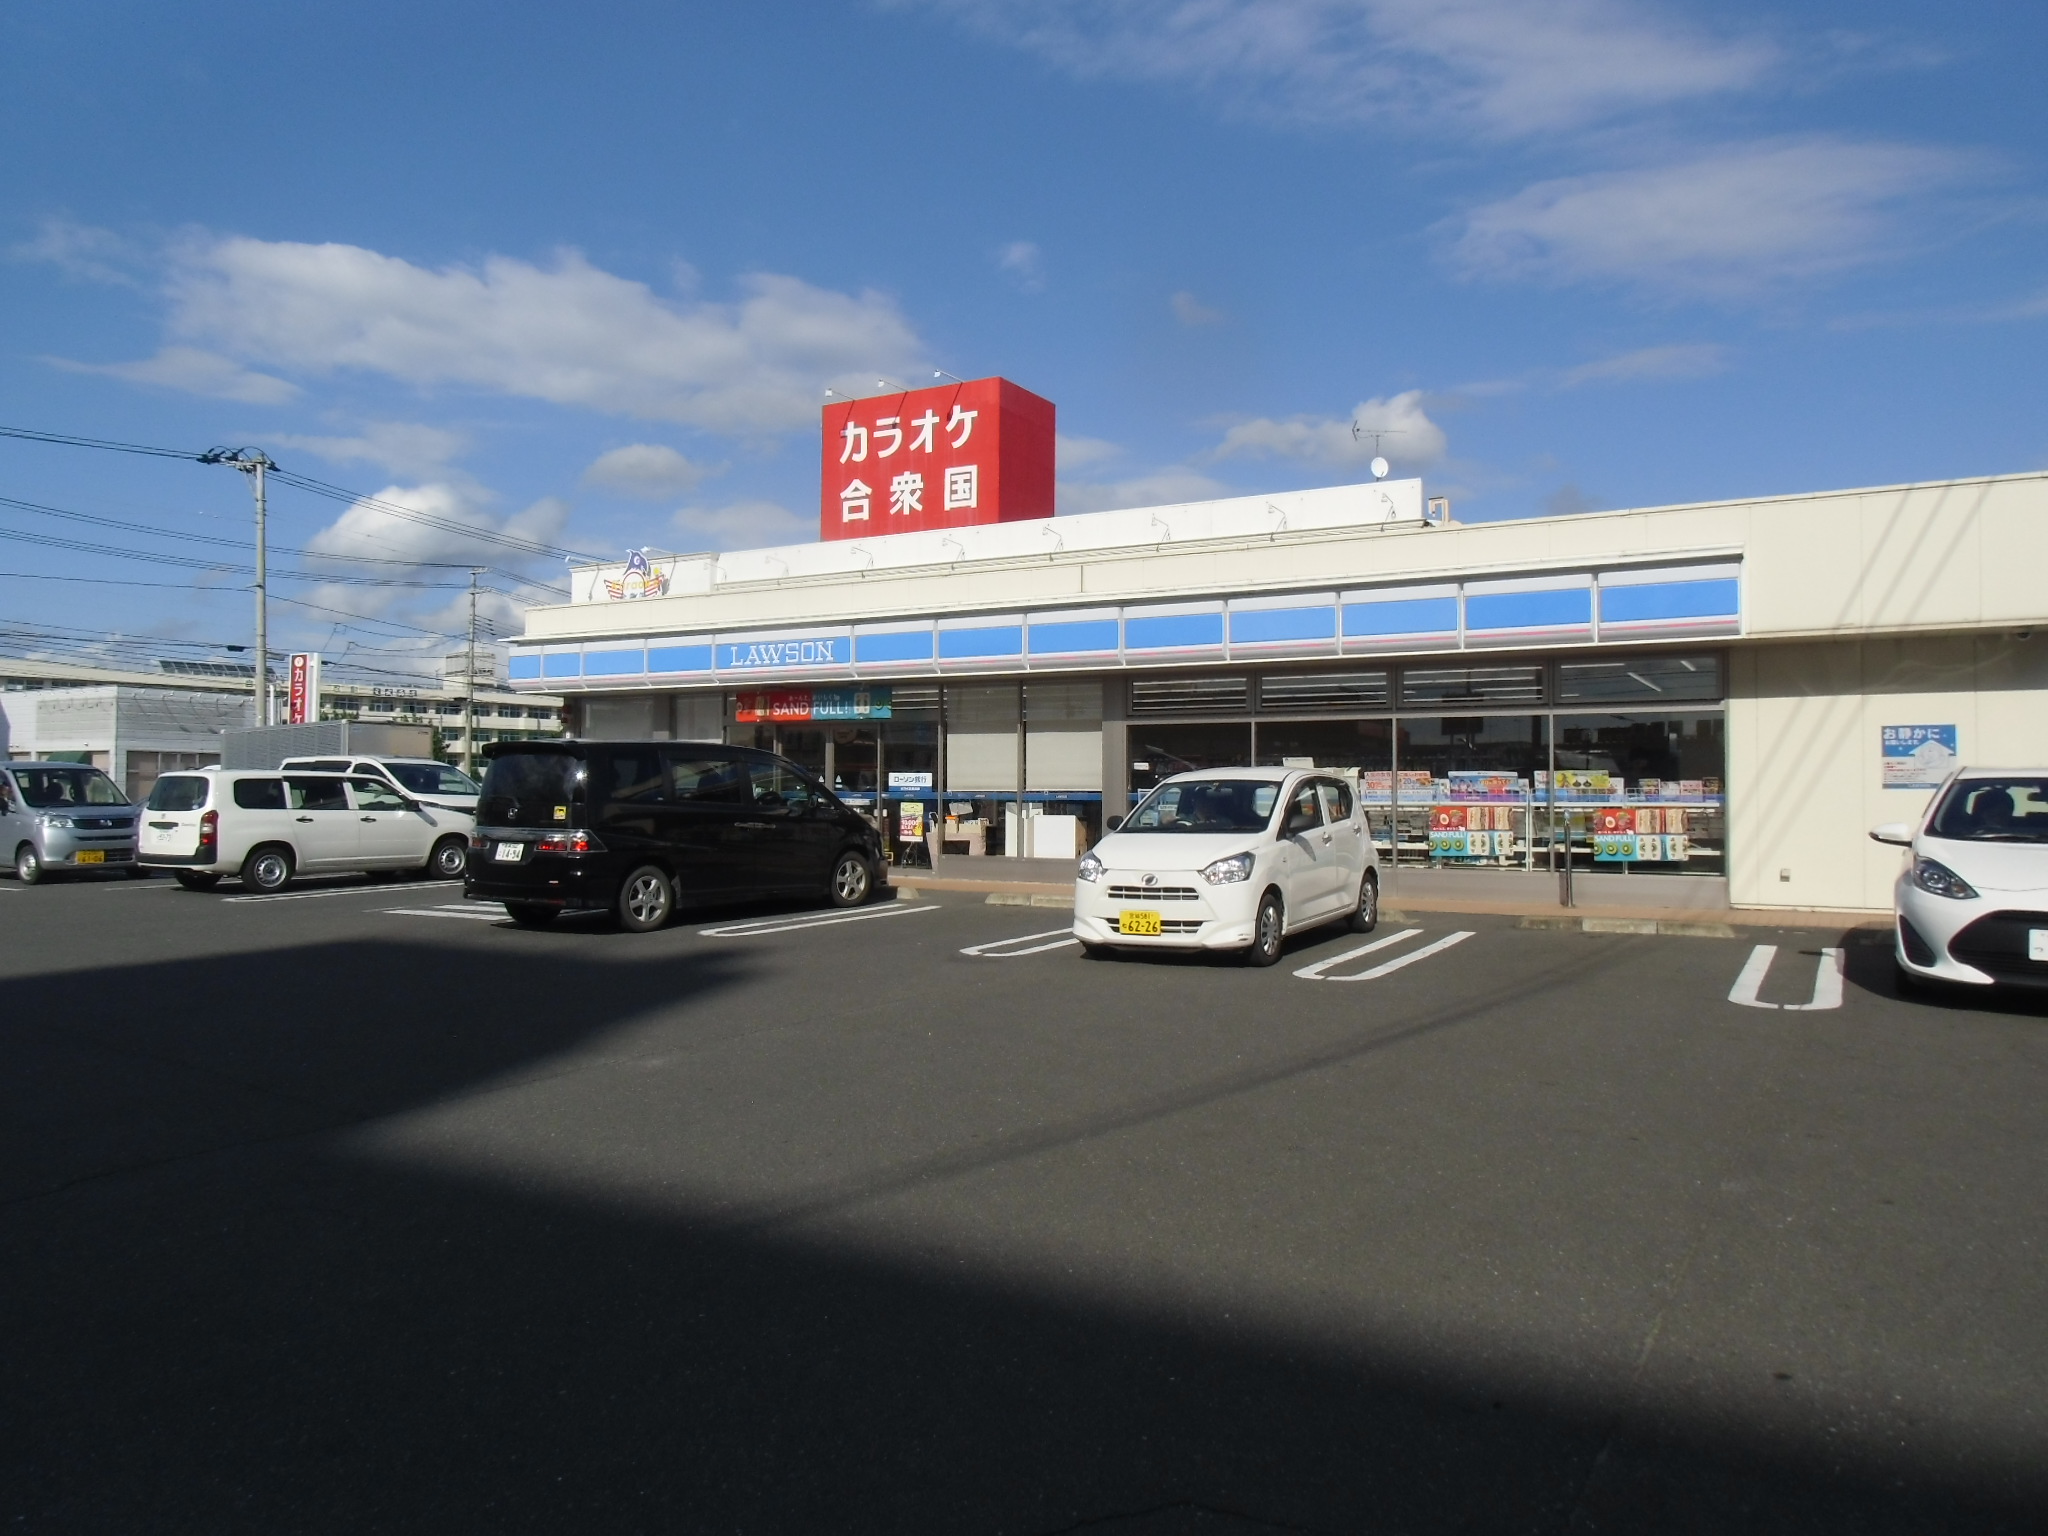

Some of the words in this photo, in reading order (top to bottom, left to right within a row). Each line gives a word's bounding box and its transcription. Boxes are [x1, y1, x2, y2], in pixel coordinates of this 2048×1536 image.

[840, 404, 979, 464] カラオケ
[839, 464, 978, 523] 合衆国
[730, 640, 835, 667] LAWSON
[773, 702, 809, 716] SAND
[812, 701, 849, 715] FULL!
